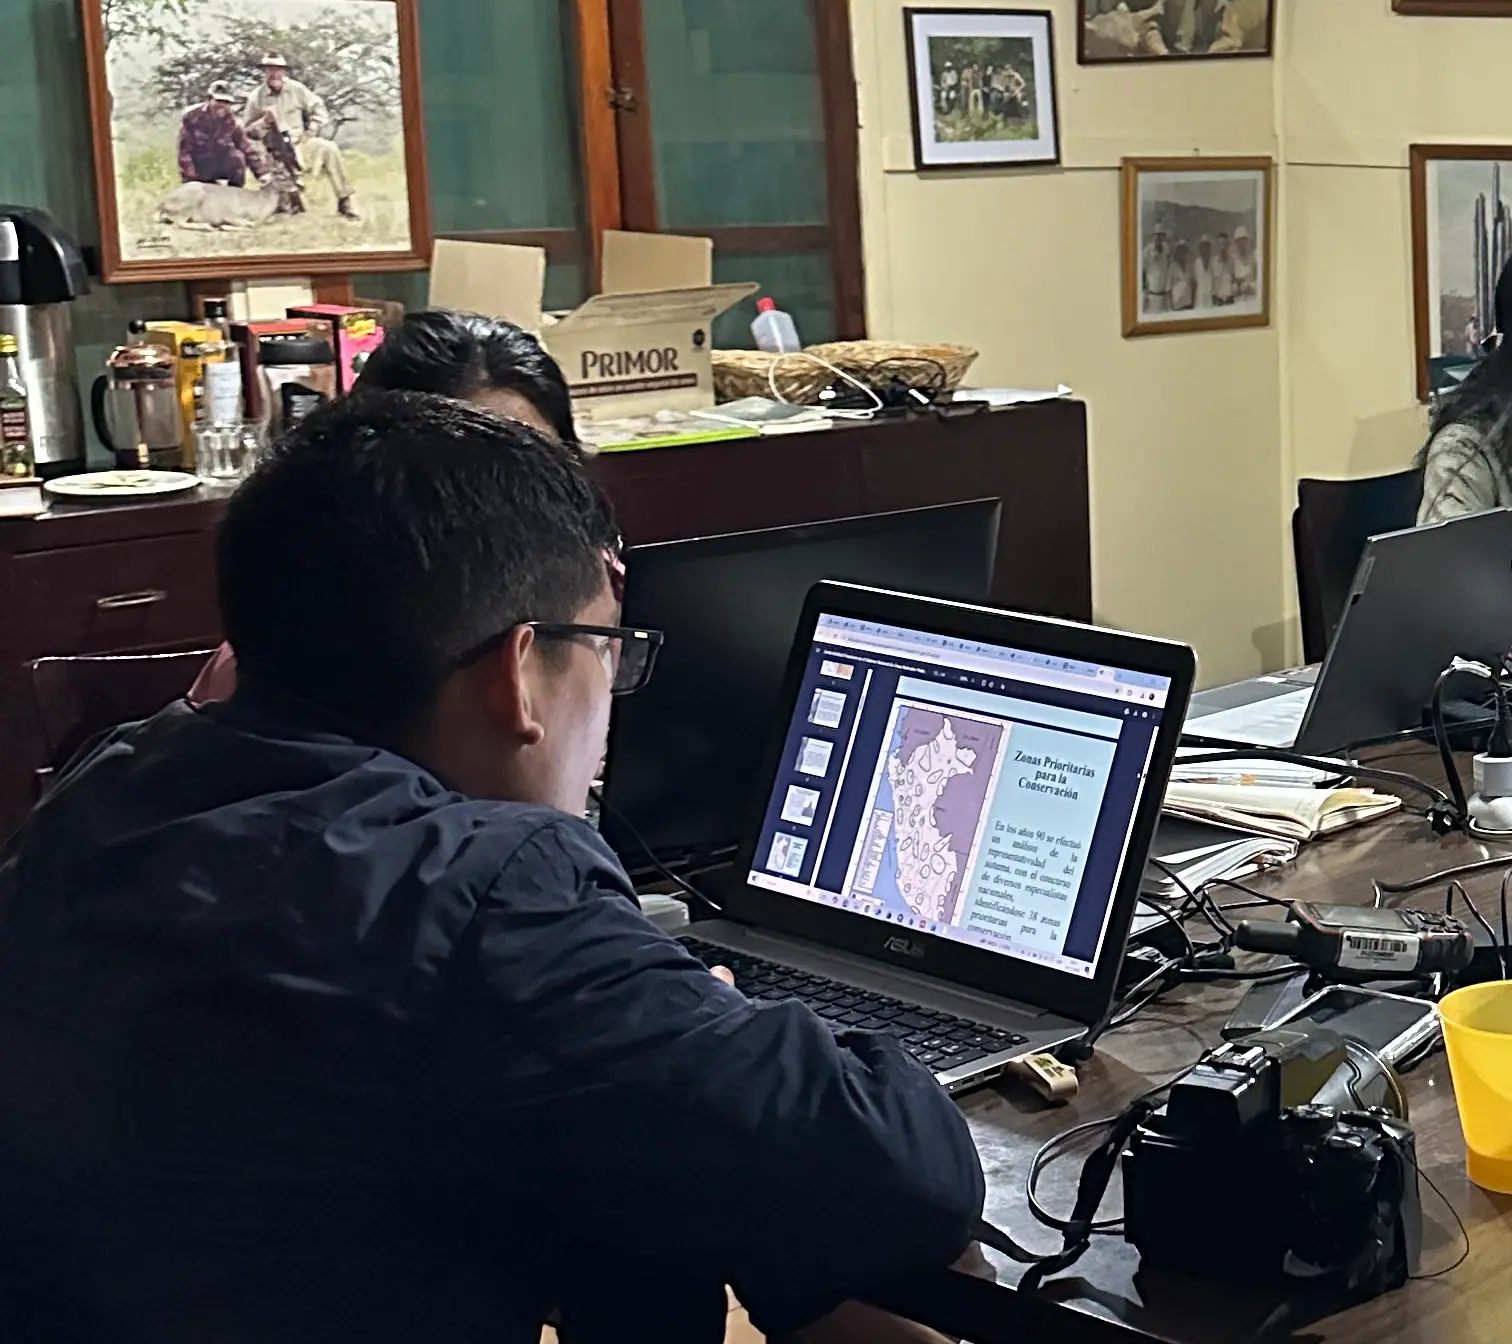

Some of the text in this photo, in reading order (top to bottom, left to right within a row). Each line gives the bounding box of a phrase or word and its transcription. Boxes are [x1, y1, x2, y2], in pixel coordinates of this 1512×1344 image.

[581, 347, 679, 379] PRIMOR
[1014, 750, 1096, 778] Zonas Prioritarias
[1018, 777, 1079, 800] Conservación
[1034, 770, 1067, 784] para la
